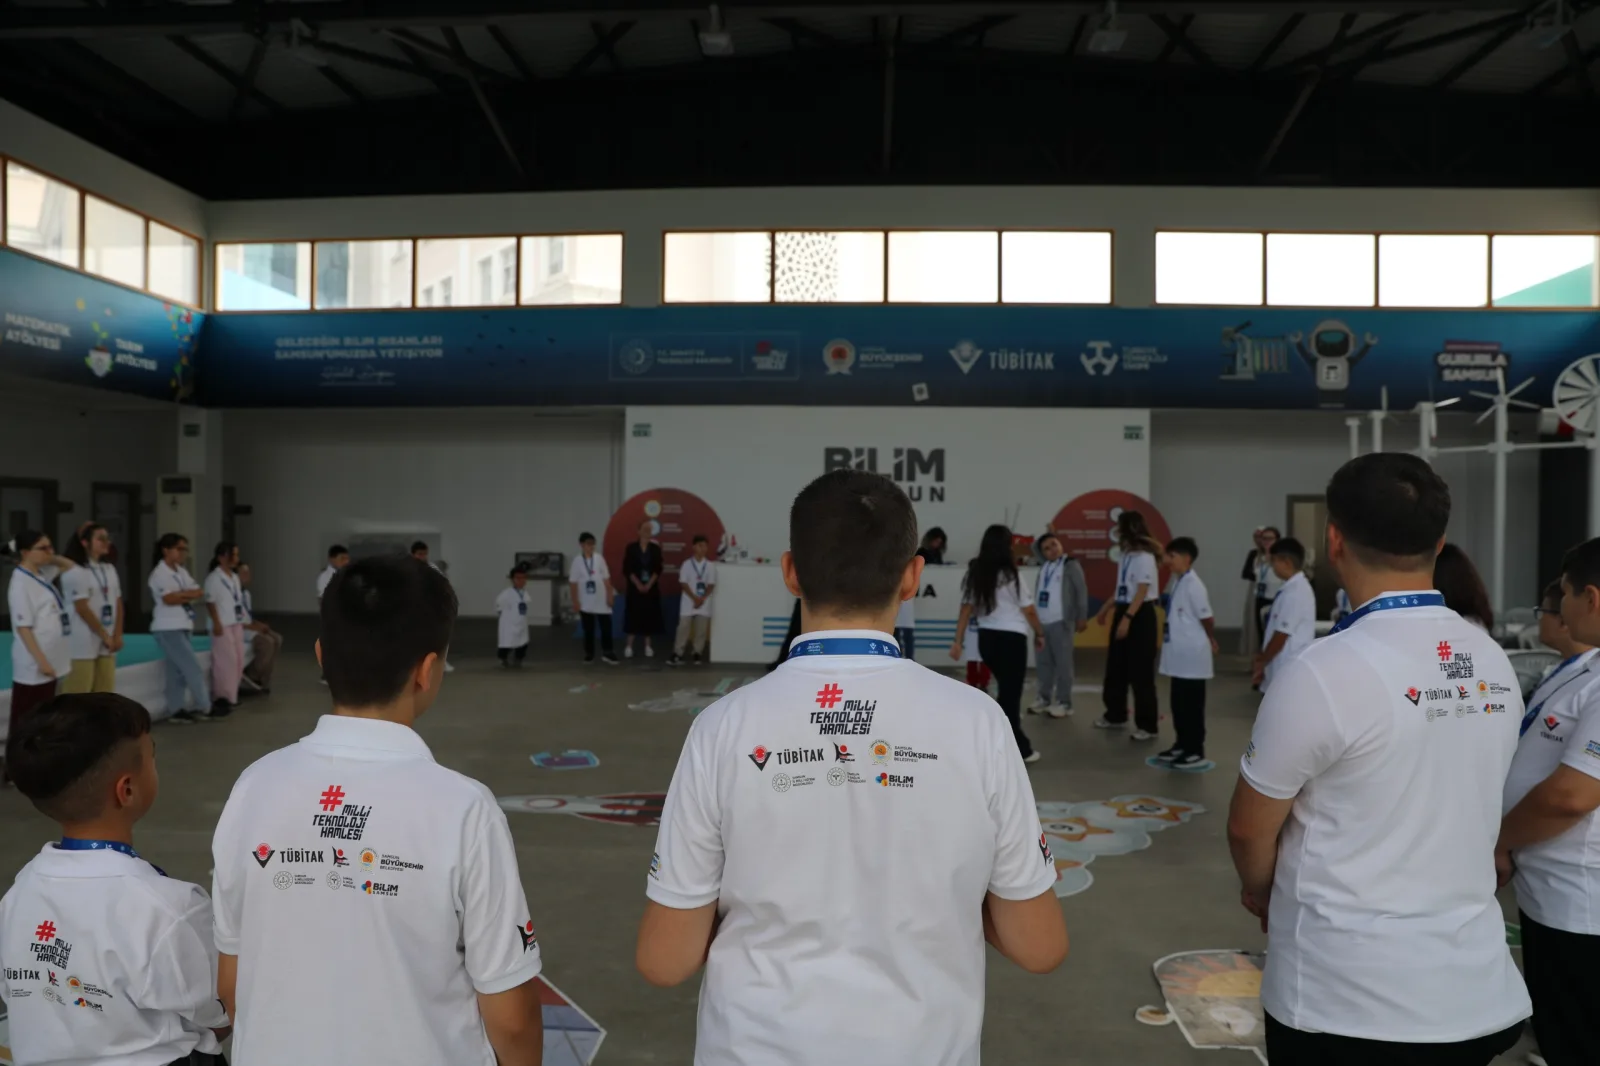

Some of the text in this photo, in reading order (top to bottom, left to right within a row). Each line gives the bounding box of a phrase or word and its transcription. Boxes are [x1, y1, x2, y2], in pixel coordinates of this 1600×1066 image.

[989, 348, 1054, 370] TÜBİTAK
[1425, 688, 1453, 701] TÜBİTAK
[810, 711, 874, 724] TEKNOLOJİ
[819, 723, 871, 735] HAMLESİ
[777, 747, 825, 765] TÜBİTAK
[894, 750, 938, 760] BÜYÜKŞEHİR
[888, 774, 914, 784] BİLİM
[312, 814, 367, 829] TEKNOLOJİ
[320, 827, 363, 841] HAMLESİ
[280, 847, 324, 864] TÜBİTAK
[380, 859, 424, 871] BÜYÜKŞEHİR
[372, 882, 399, 893] BİLİM
